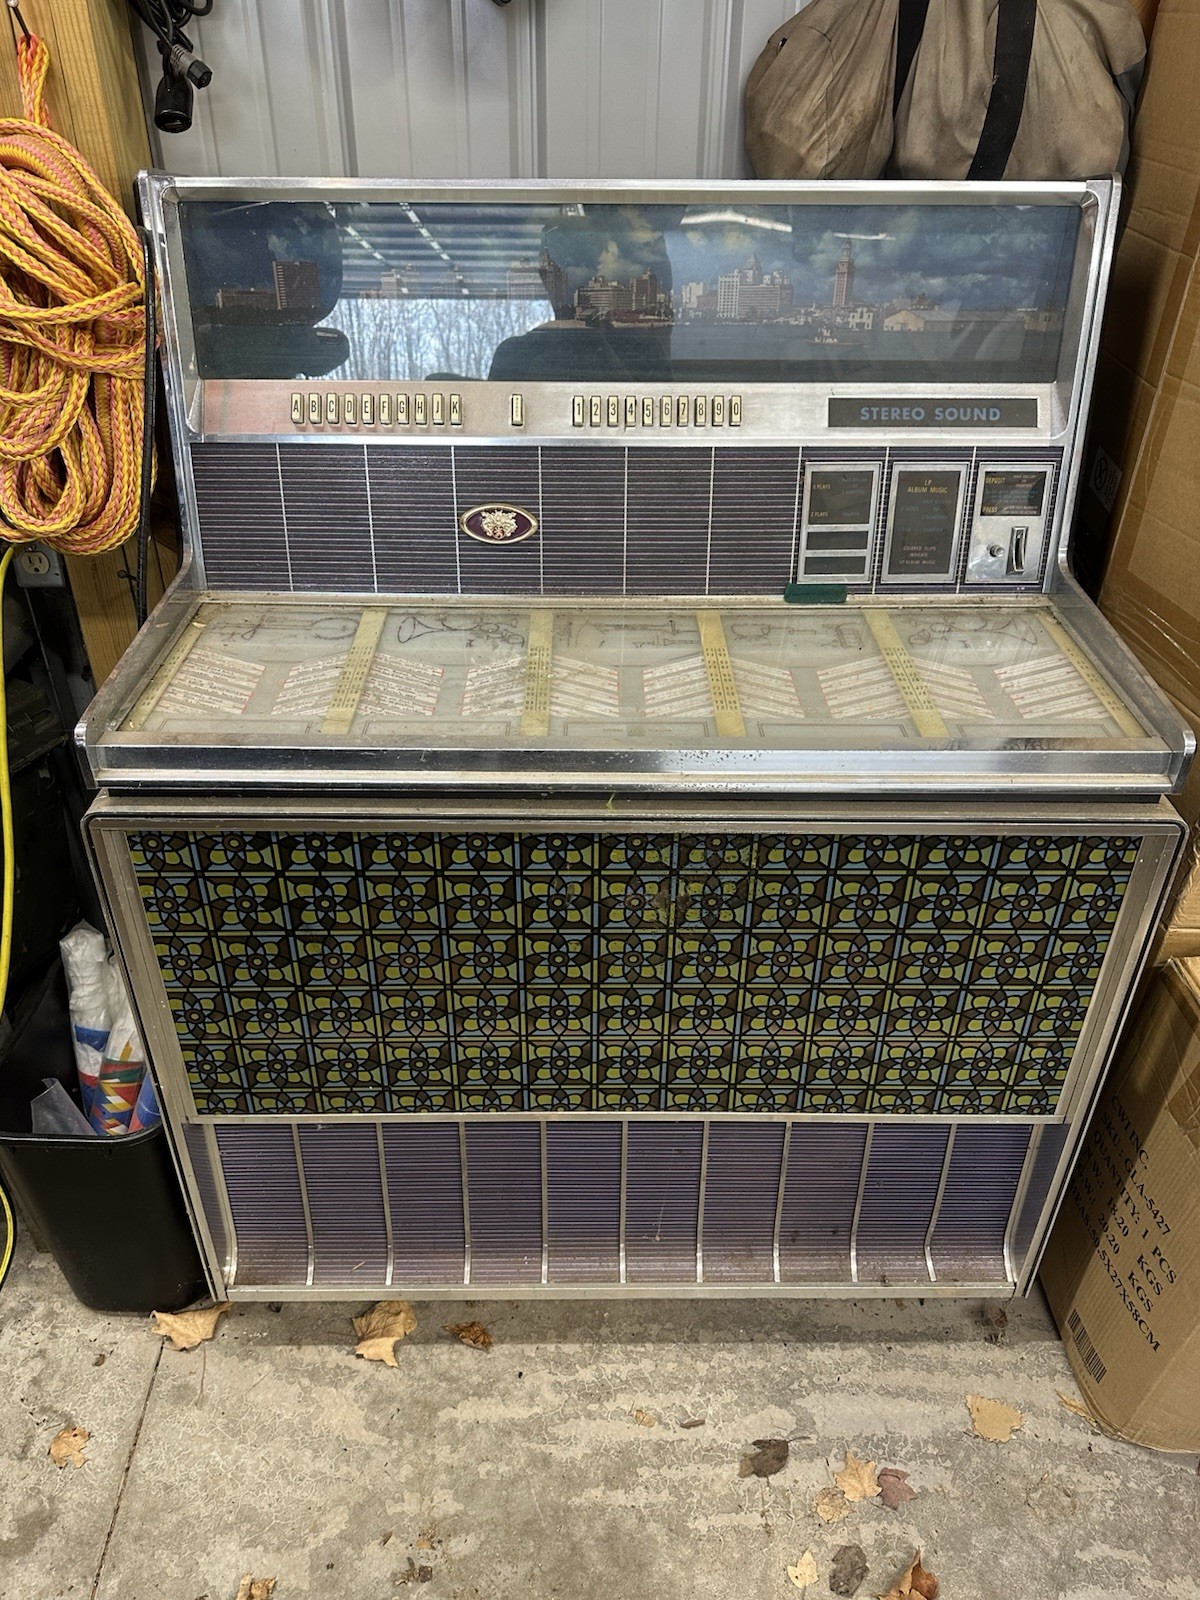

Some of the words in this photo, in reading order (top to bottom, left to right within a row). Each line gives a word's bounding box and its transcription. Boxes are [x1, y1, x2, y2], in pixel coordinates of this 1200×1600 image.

[860, 406, 926, 421] STEREO
[934, 407, 1001, 421] SOUND
[906, 486, 928, 494] ALBUM
[930, 486, 948, 494] MUSIC
[1112, 1095, 1131, 1131] CWI
[1129, 1130, 1149, 1170] INC.
[1094, 1129, 1140, 1225] QUANTITY:
[1151, 1245, 1177, 1284] PCS
[1124, 1157, 1171, 1235] GLA-5427
[1098, 1212, 1120, 1254] 20.20
[1127, 1270, 1154, 1312] KGS
[1107, 1196, 1129, 1237] 18.20
[1136, 1253, 1164, 1296] KGS
